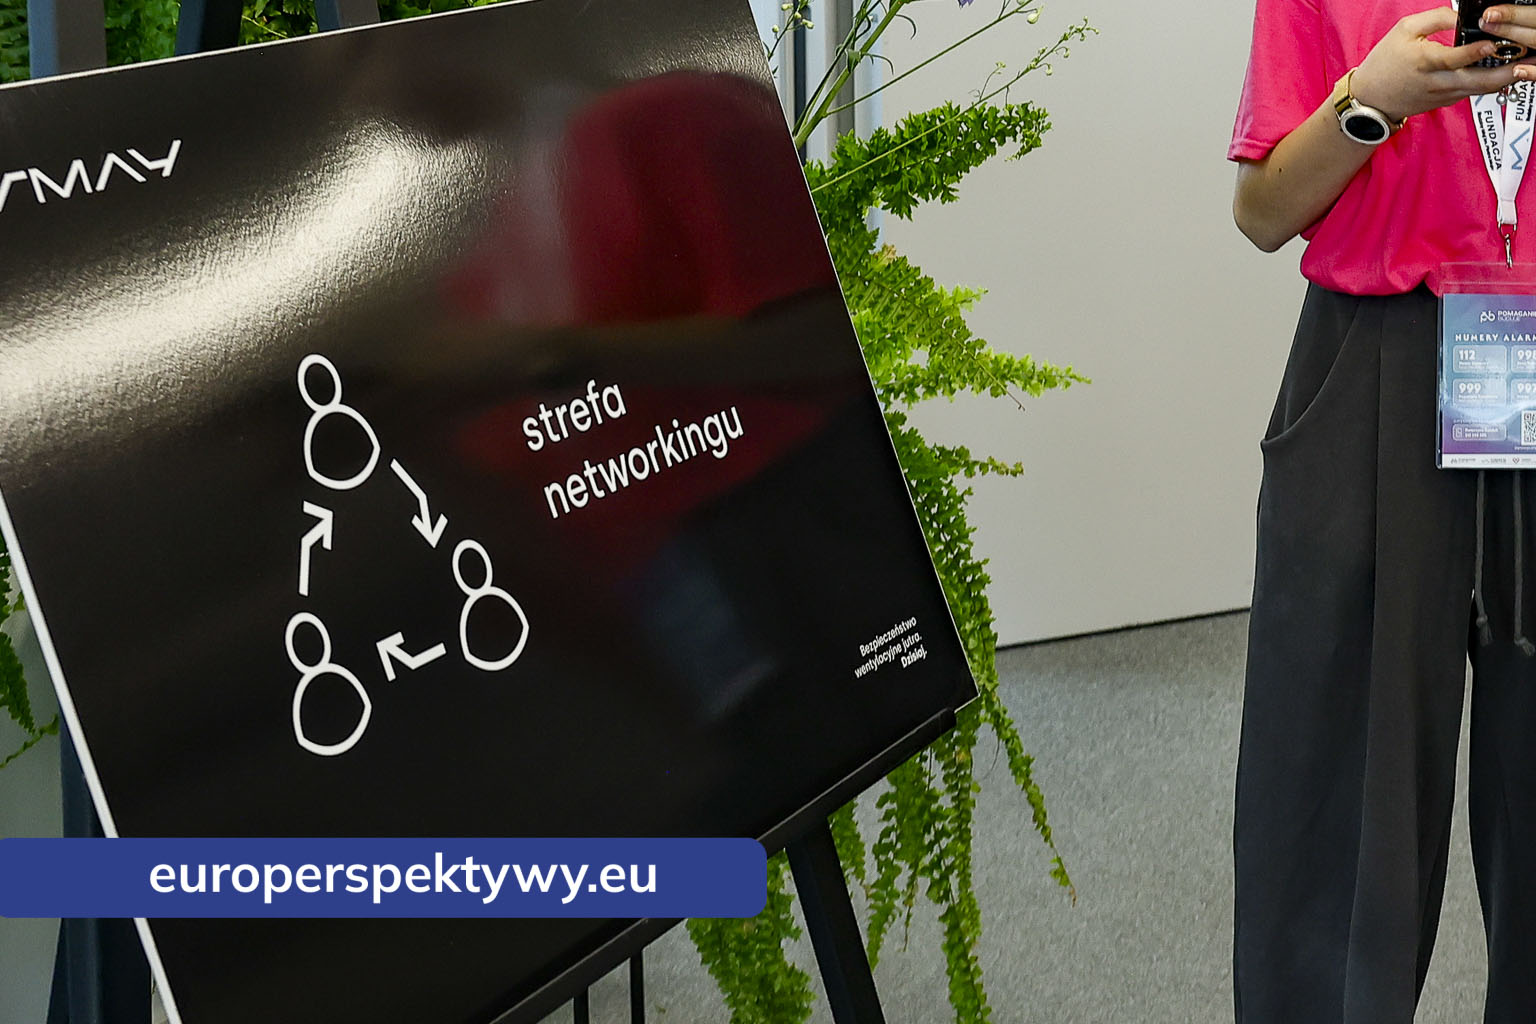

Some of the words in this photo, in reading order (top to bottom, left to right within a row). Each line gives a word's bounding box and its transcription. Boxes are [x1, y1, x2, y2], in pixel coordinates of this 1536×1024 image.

[1515, 79, 1529, 122] FUNDA
[1484, 109, 1502, 170] FUNDACJA
[1455, 334, 1499, 343] NUMERY
[1459, 350, 1476, 361] 112
[1459, 383, 1482, 394] 999
[522, 379, 627, 451] strefa
[543, 405, 744, 519] networkingu
[859, 616, 917, 657] Bezpieczeństwo
[854, 643, 902, 679] wentylacyjne
